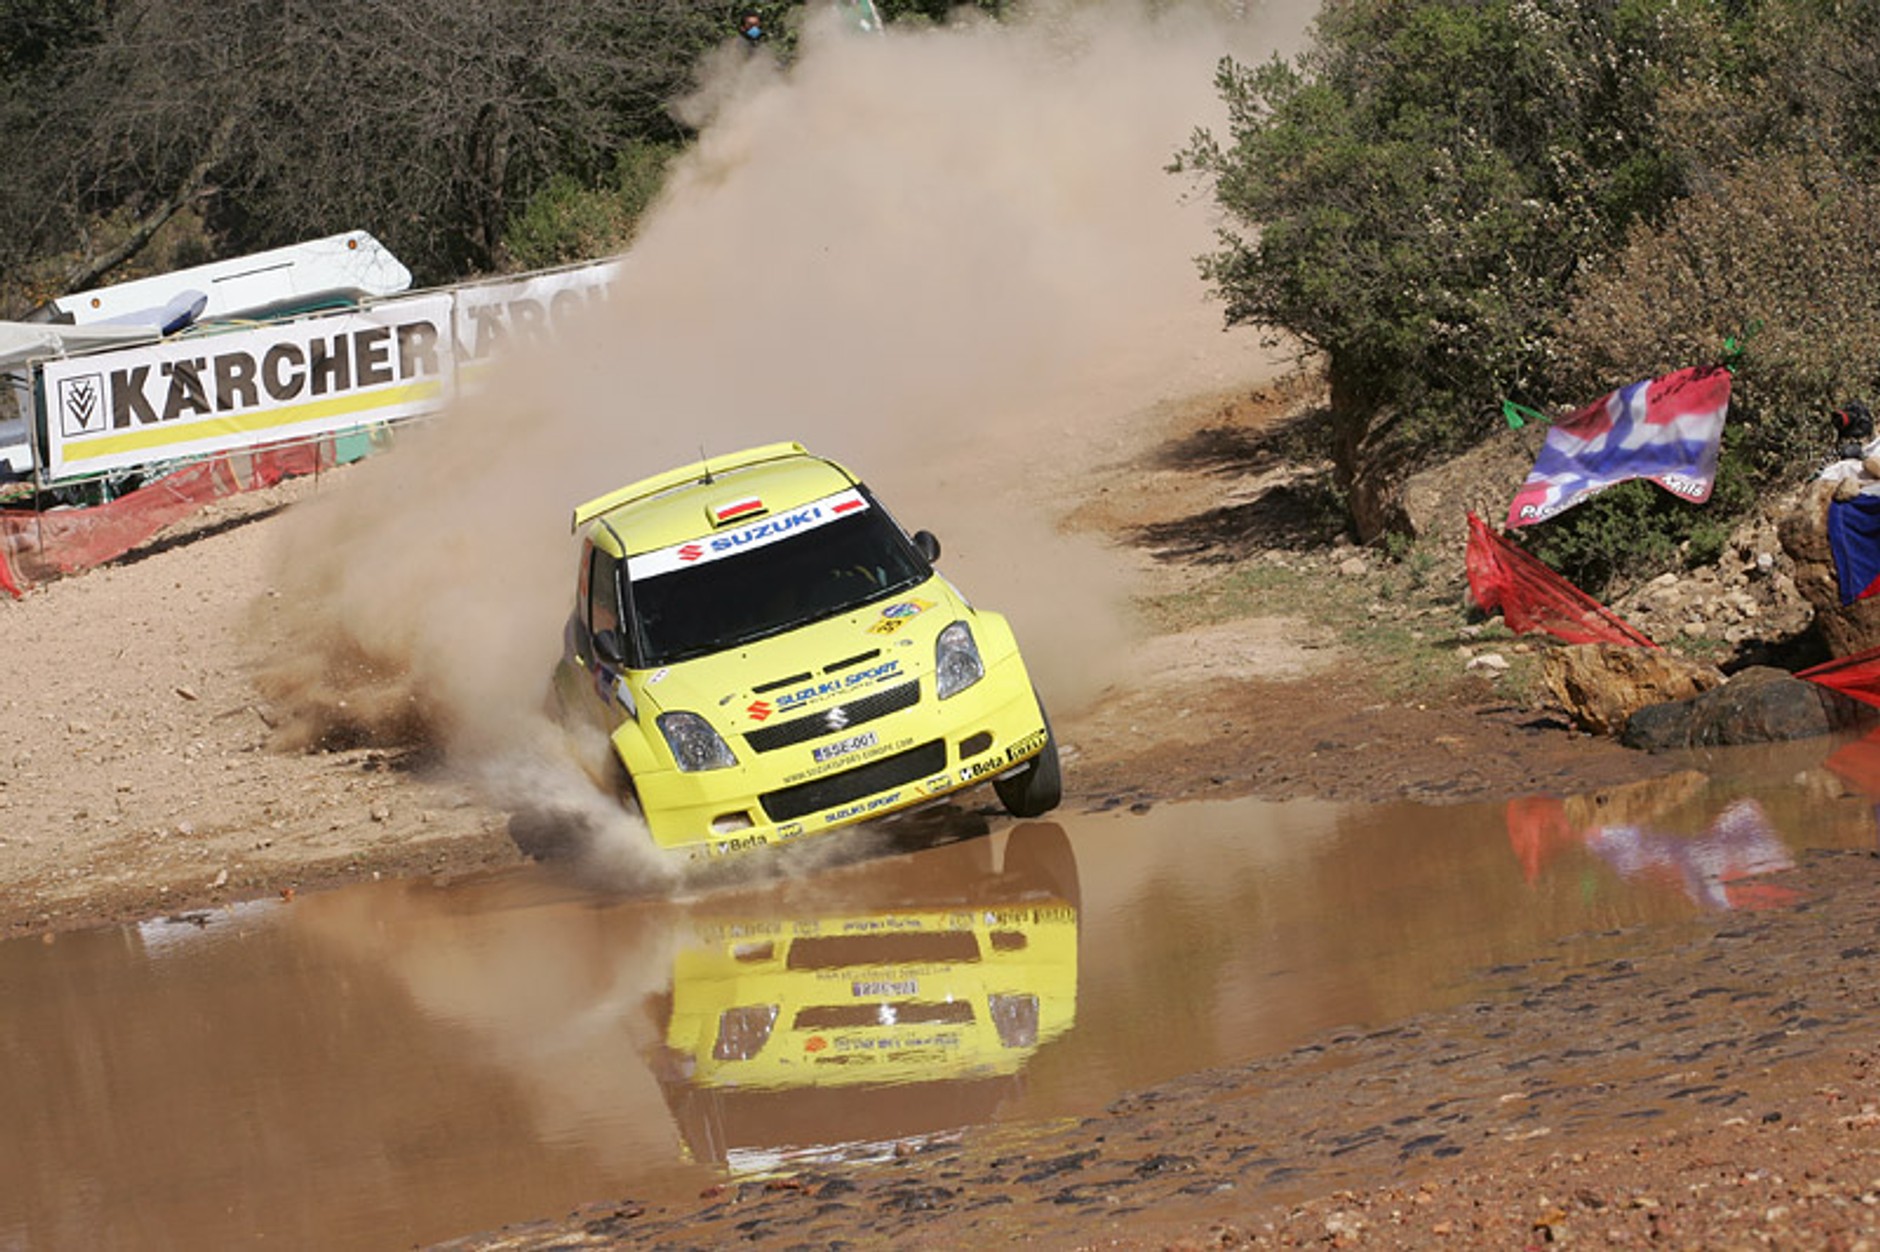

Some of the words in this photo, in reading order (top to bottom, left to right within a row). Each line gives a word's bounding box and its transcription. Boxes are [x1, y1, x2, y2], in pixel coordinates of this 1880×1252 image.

[109, 321, 440, 428] KÄRCHER
[710, 507, 822, 551] SUZUKI
[776, 680, 842, 706] SUZUKI
[845, 660, 899, 687] SPORT
[972, 756, 1004, 777] Beta
[825, 804, 866, 823] SUZUKI
[867, 792, 901, 811] SPORT
[730, 834, 768, 852] Beta
